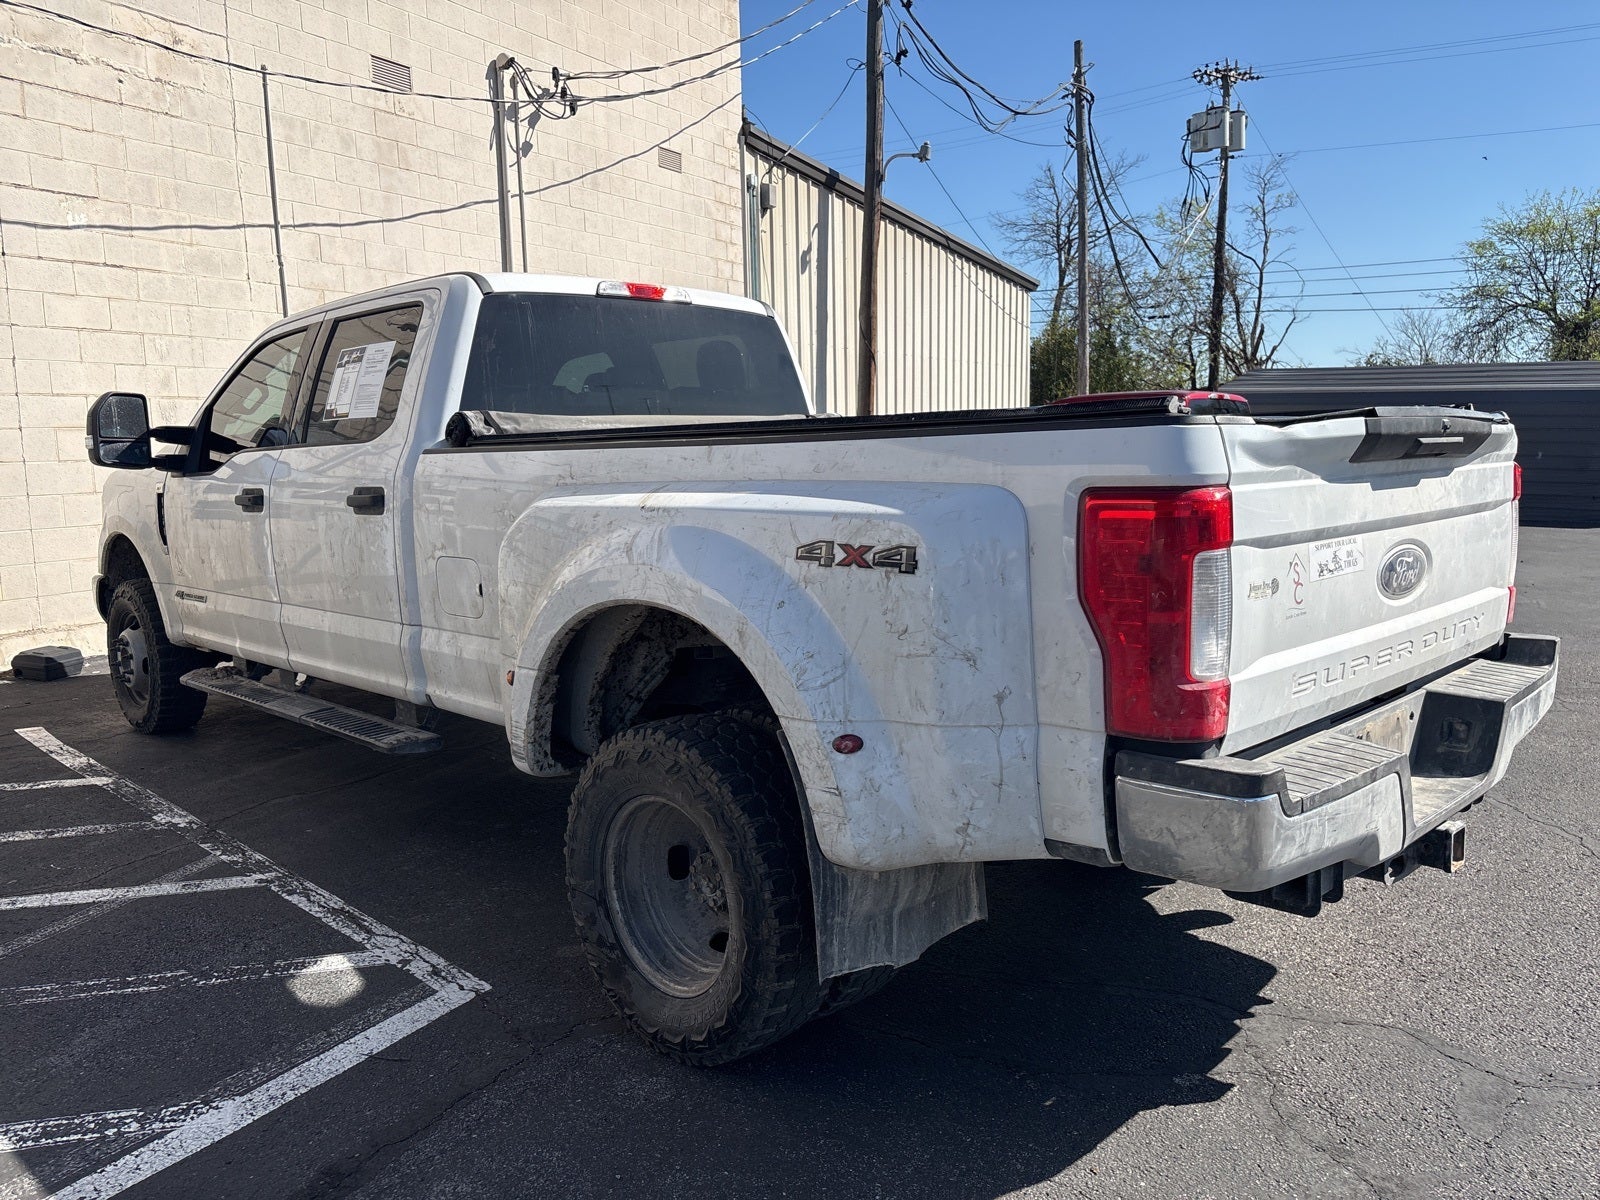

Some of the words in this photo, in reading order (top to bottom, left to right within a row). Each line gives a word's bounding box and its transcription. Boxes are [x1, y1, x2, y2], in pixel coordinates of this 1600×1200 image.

[1391, 556, 1420, 588] Ford
[1291, 640, 1413, 699] SUPER
[1421, 612, 1485, 652] DUTY
